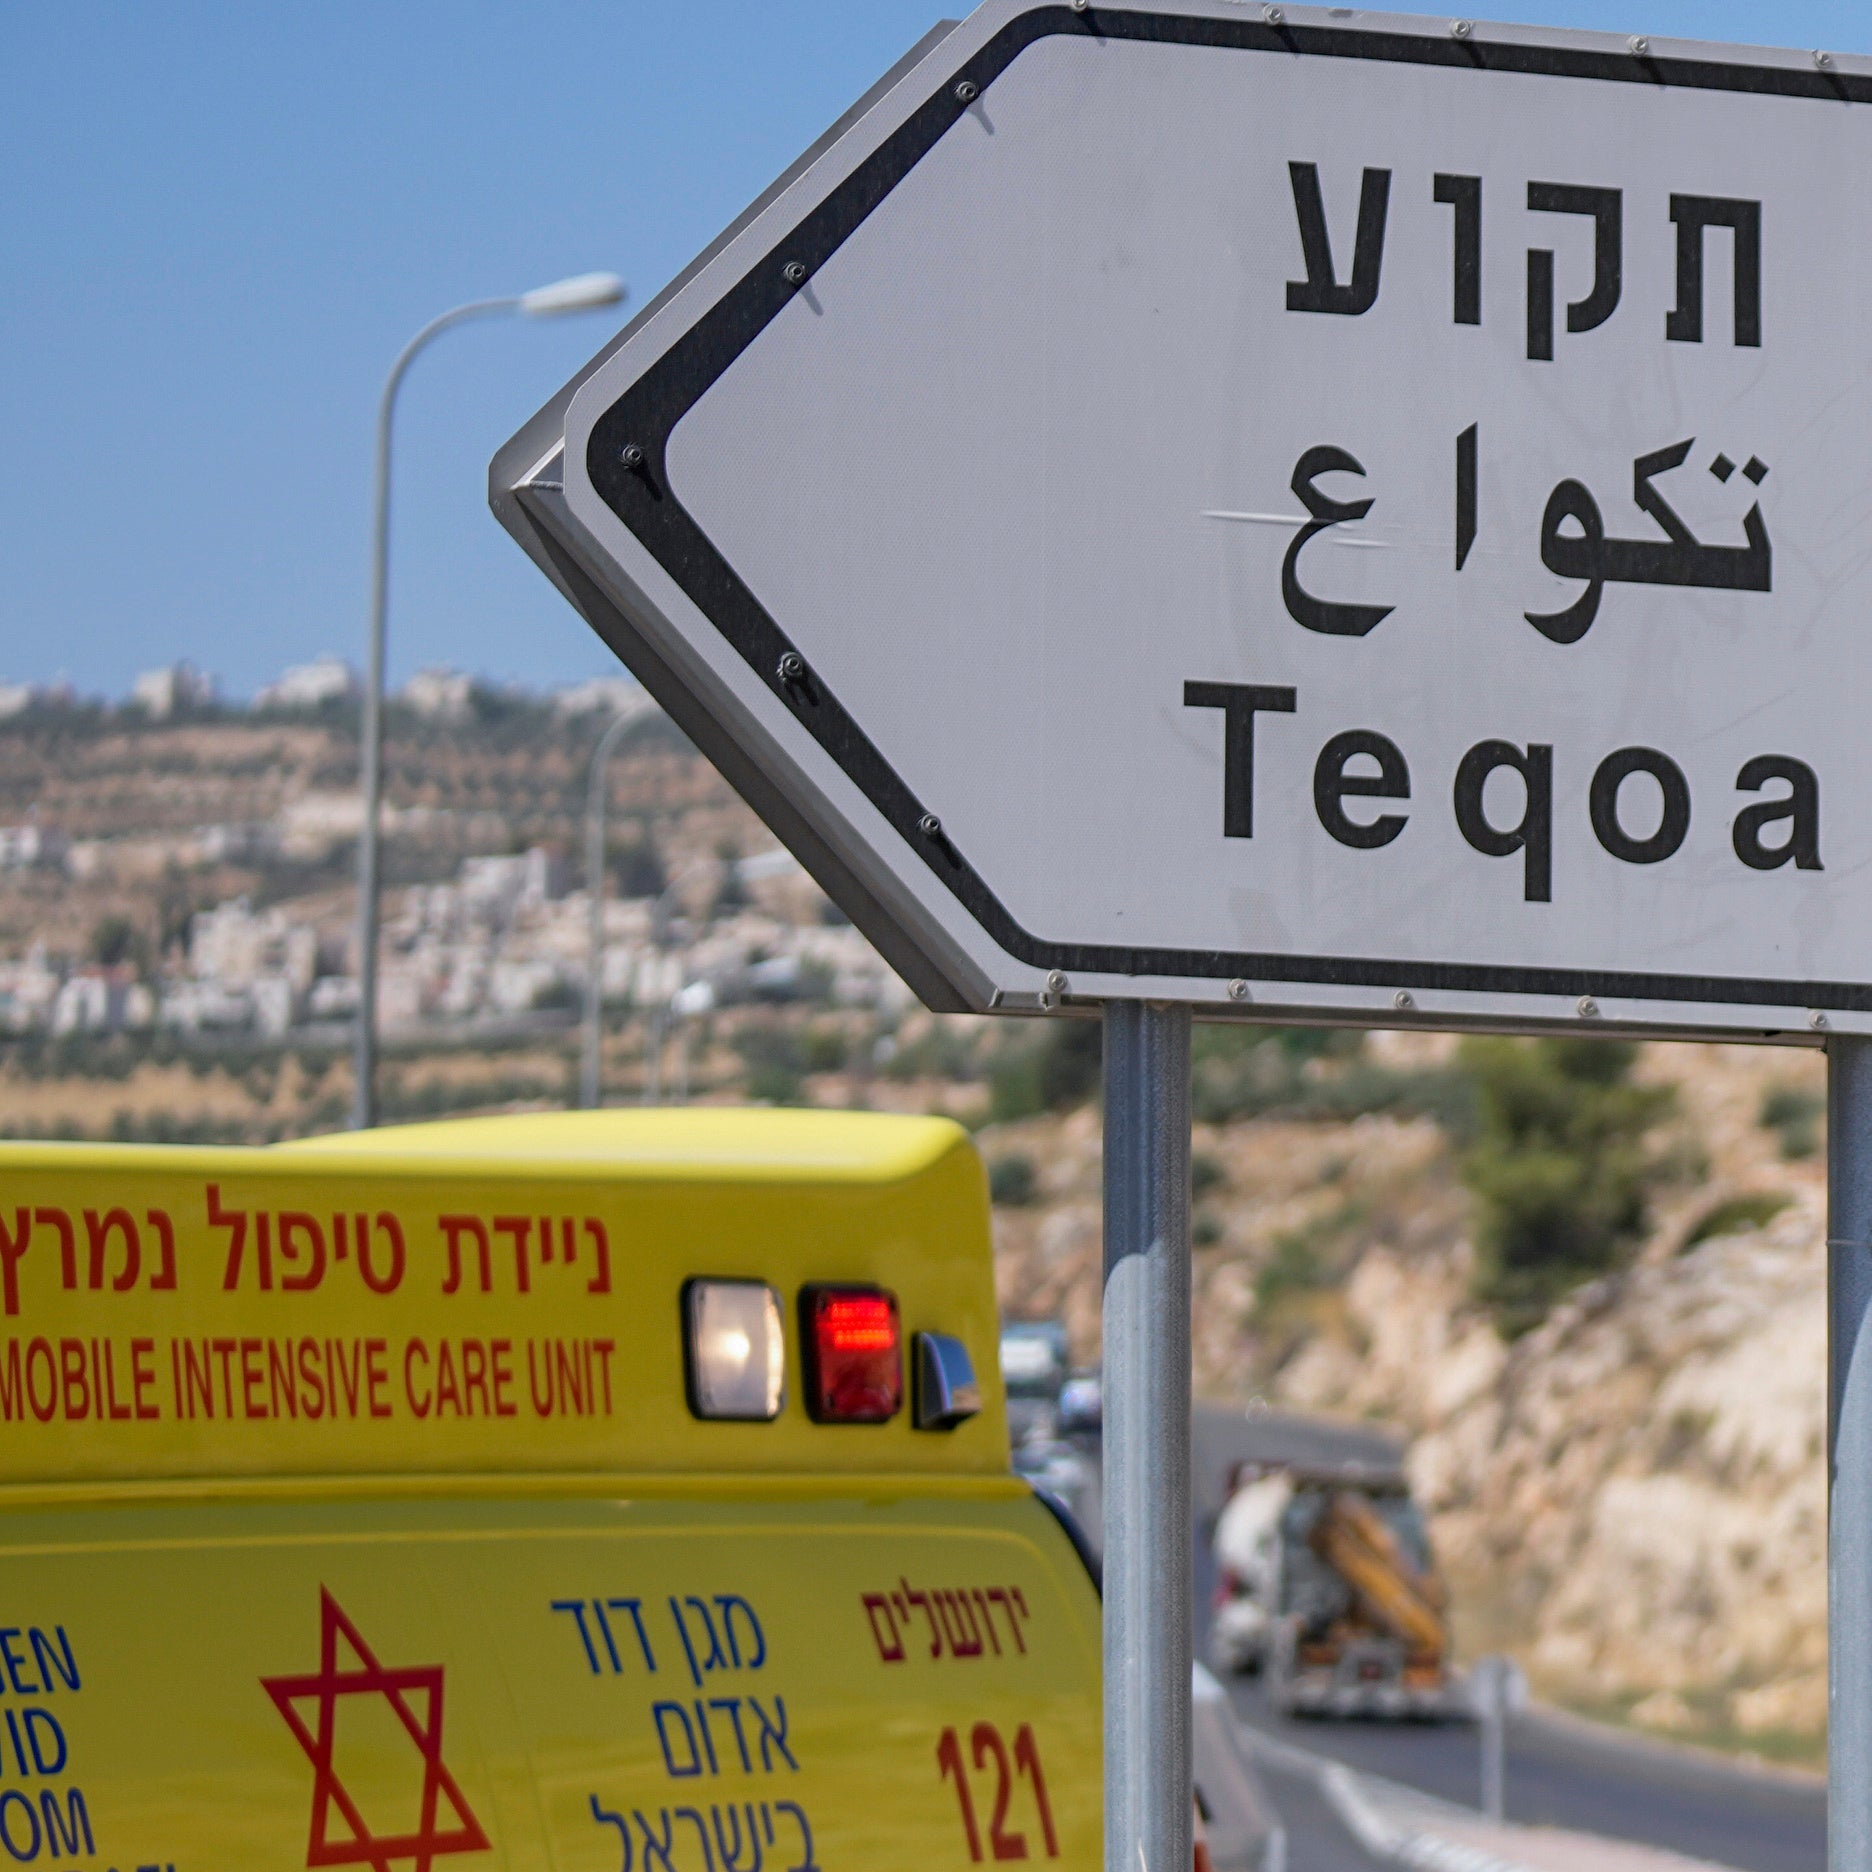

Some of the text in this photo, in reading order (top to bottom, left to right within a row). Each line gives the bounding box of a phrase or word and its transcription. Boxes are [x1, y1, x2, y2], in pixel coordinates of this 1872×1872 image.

[1285, 159, 1763, 362] תקוע
[1280, 419, 1774, 645] تكواع
[1182, 677, 1825, 902] Teqoa
[0, 1182, 612, 1317] ניידת טיפול נמרץ
[170, 1335, 394, 1421] INTENSIVE
[403, 1335, 518, 1420] CARE
[527, 1336, 616, 1418] UNIT
[550, 1593, 767, 1689] מגן דוד
[860, 1574, 1030, 1664] ירושלים
[652, 1693, 800, 1780] אדום
[935, 1719, 1061, 1864] 121
